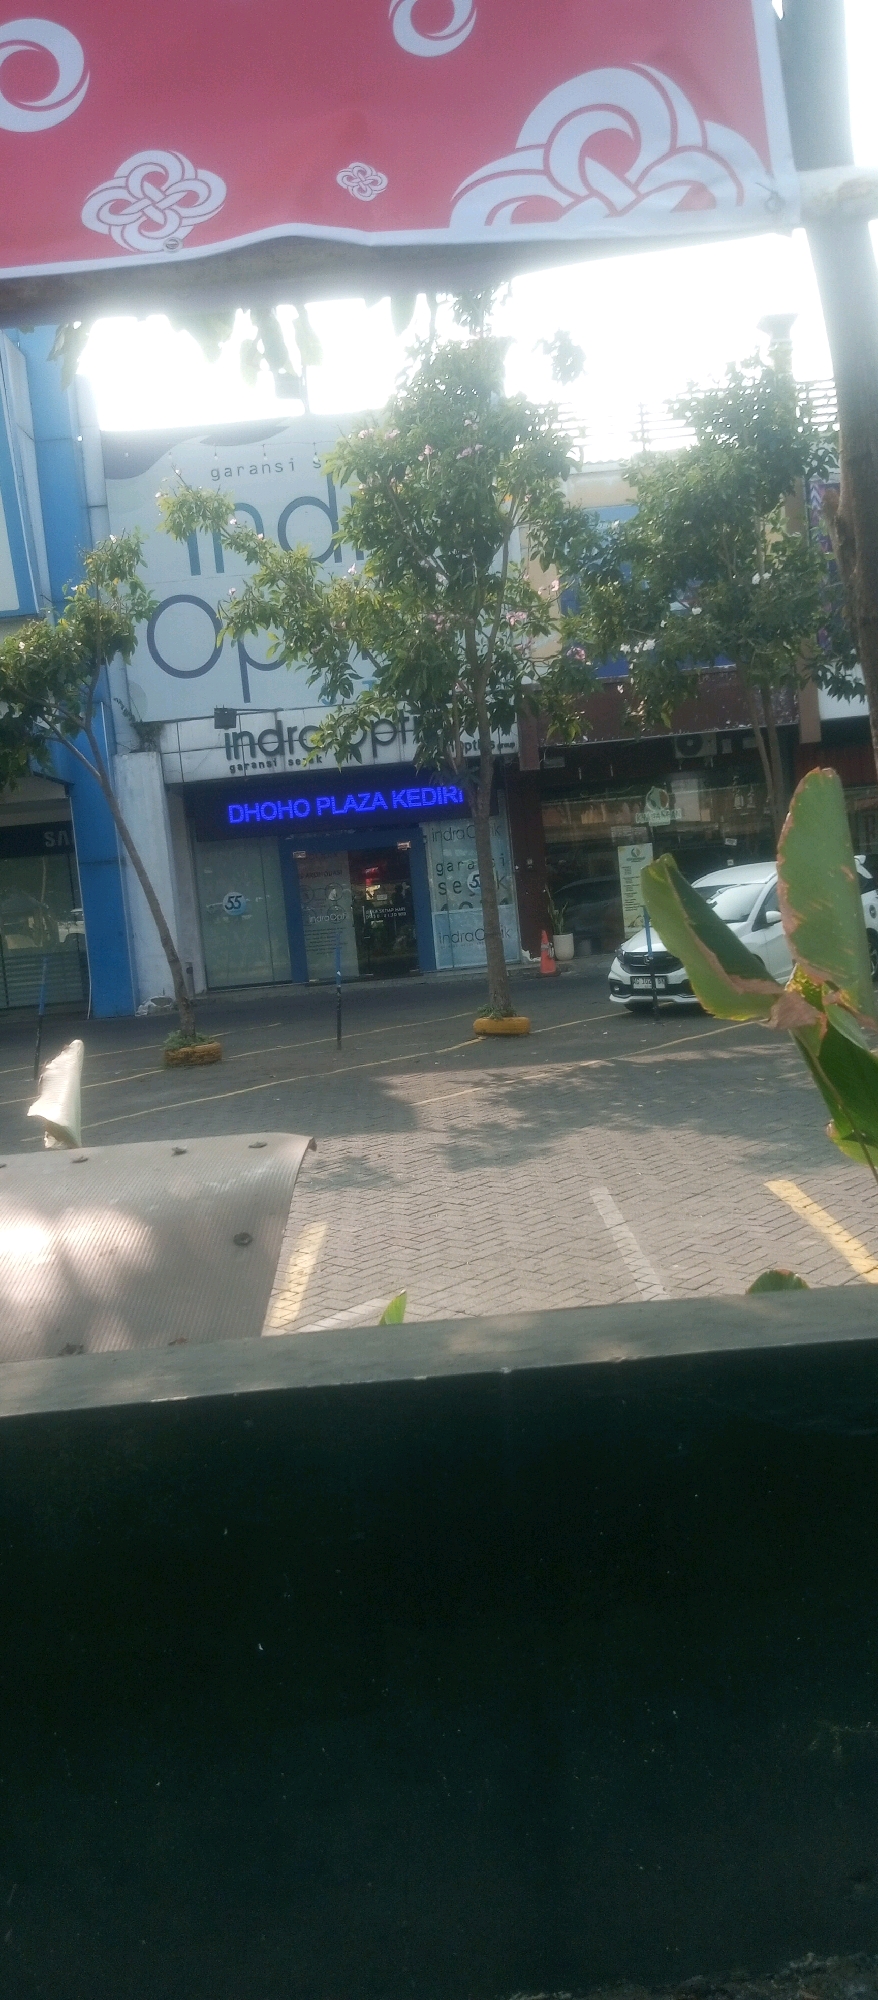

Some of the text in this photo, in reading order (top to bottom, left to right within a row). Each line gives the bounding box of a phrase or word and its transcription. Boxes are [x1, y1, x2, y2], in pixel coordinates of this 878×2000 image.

[210, 457, 295, 481] garansi
[229, 754, 323, 774] garansi seak
[227, 786, 464, 825] DHOHO PLAZA KEDIRI
[224, 895, 243, 911] 55
